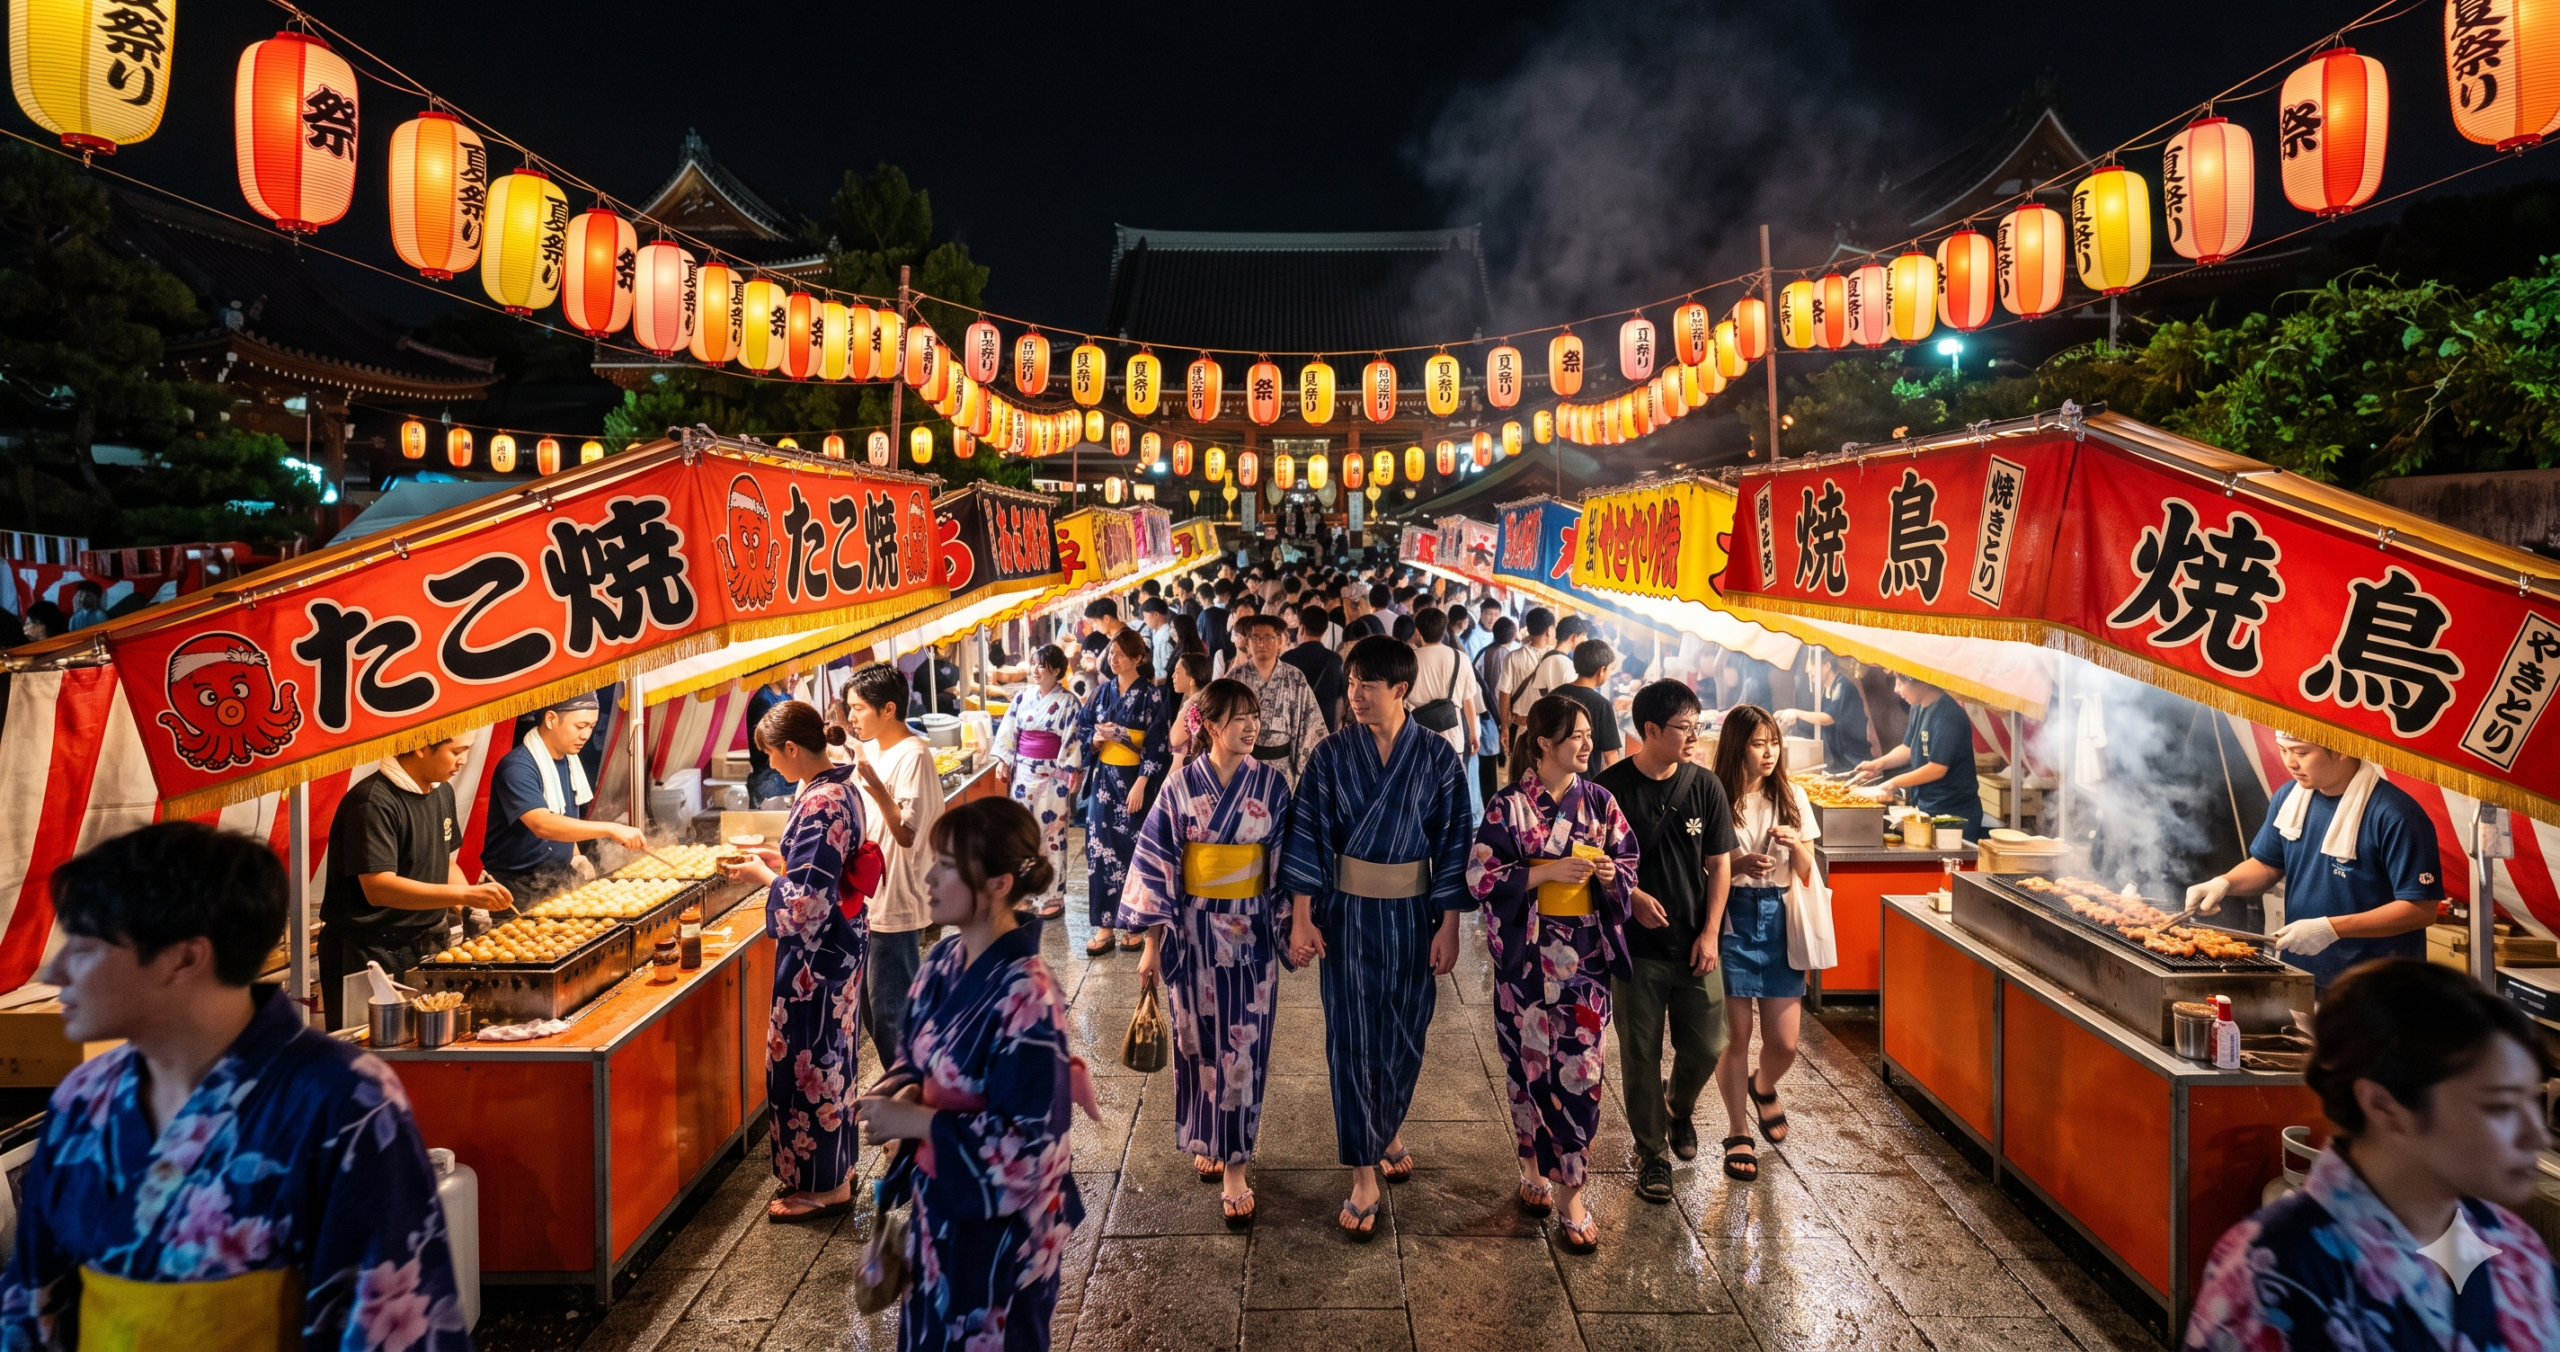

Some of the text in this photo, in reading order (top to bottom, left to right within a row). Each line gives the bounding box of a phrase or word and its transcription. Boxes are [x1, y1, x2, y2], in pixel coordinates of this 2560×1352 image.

[302, 85, 357, 162] 祭
[2281, 101, 2323, 160] 祭
[459, 142, 486, 250] 夏祭り
[2072, 190, 2094, 275] 夏祭り
[2163, 146, 2187, 243] 夏祭り
[541, 195, 568, 291] 夏祭り
[1133, 361, 1148, 403] 夏祭り
[1254, 378, 1274, 401] 祭
[1438, 361, 1452, 403] 夏祭り
[1498, 354, 1512, 396] 夏祭り
[1562, 349, 1580, 373] 祭
[784, 484, 899, 602] たこ焼
[1796, 471, 1947, 602] 焼鳥
[1978, 470, 2015, 592] 焼きとり
[295, 497, 697, 731] たこ焼
[2110, 501, 2461, 734] 焼鳥
[2483, 630, 2560, 754] やきとり
